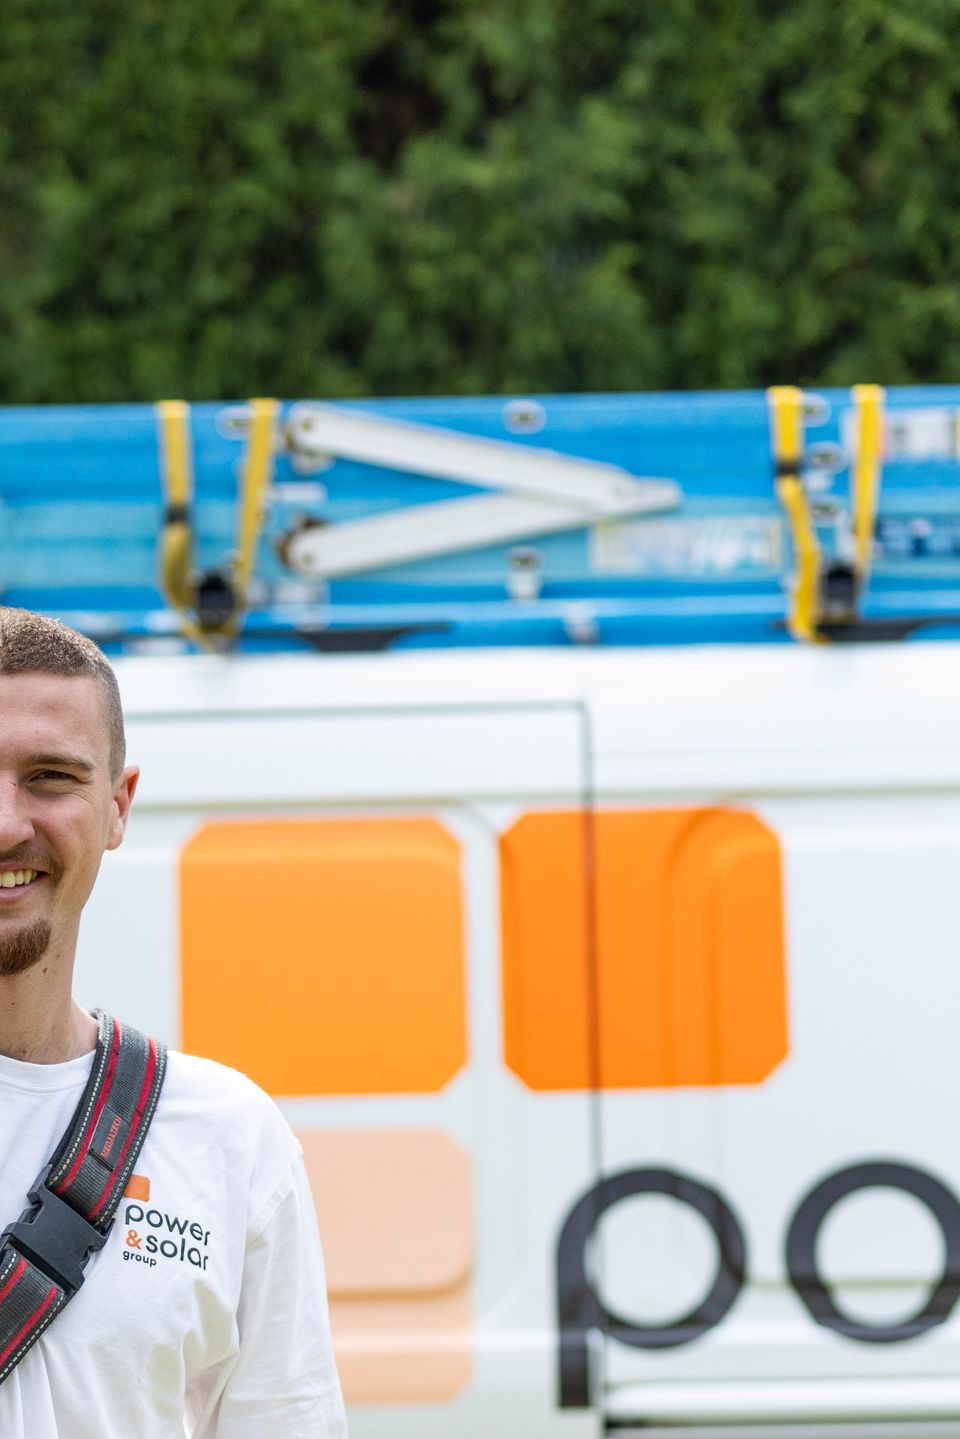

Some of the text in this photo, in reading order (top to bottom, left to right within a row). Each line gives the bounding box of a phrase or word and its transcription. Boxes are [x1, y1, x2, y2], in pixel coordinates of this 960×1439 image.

[125, 1204, 210, 1246] power
[123, 1250, 157, 1267] group
[126, 1229, 209, 1271] & solar
[555, 1157, 960, 1409] po
